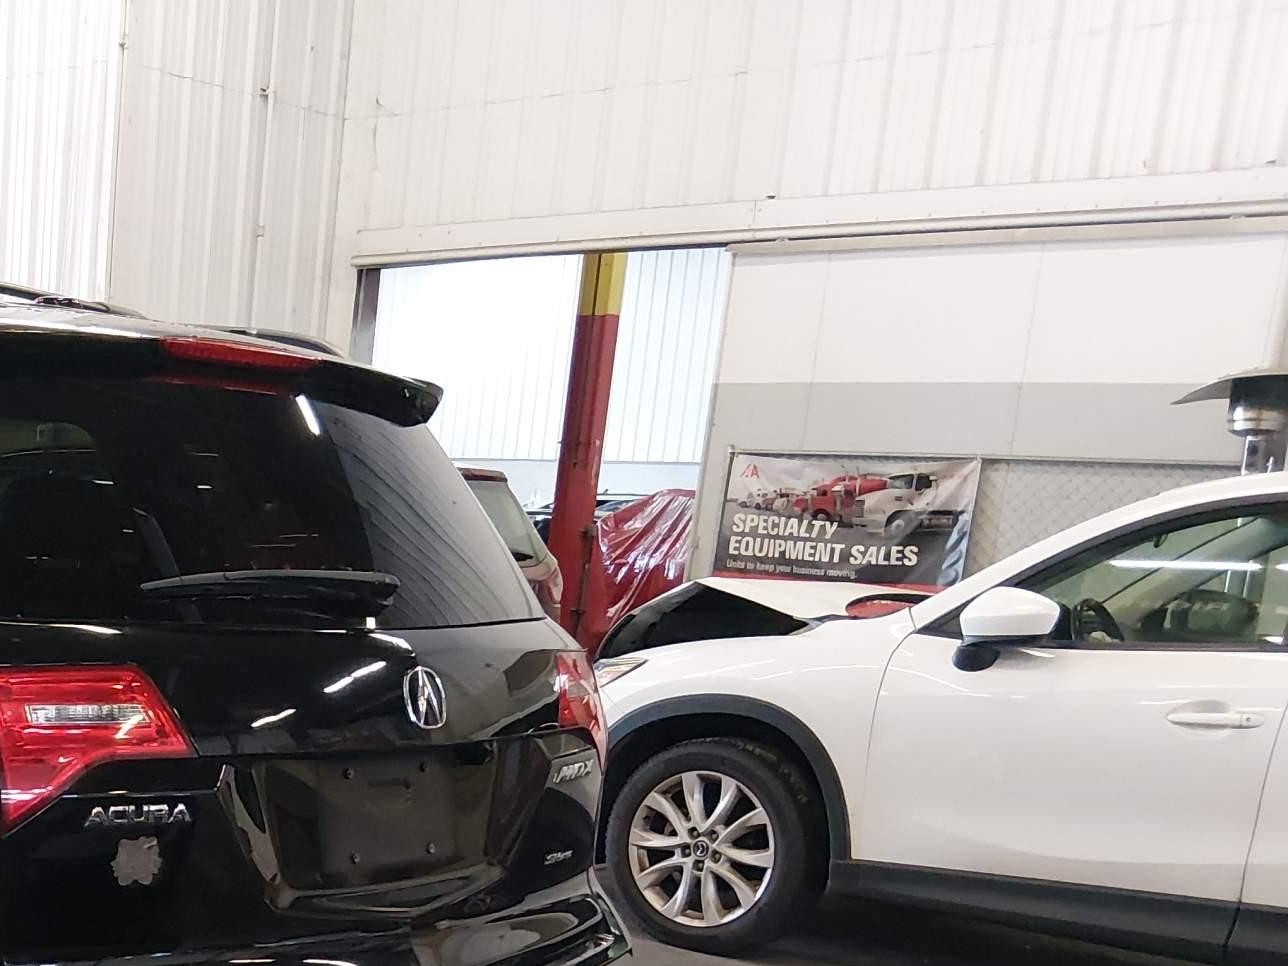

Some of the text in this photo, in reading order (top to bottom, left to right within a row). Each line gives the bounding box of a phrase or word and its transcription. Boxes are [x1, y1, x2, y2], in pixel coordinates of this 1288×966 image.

[732, 513, 838, 539] SPECIALTY
[728, 535, 919, 567] EQUIPMENT SALES
[726, 559, 745, 568] Units
[746, 561, 755, 569] to
[756, 561, 775, 573] keep
[775, 564, 792, 574] your
[792, 565, 825, 576] business
[552, 759, 593, 784] MDX
[84, 803, 192, 827] ACURA
